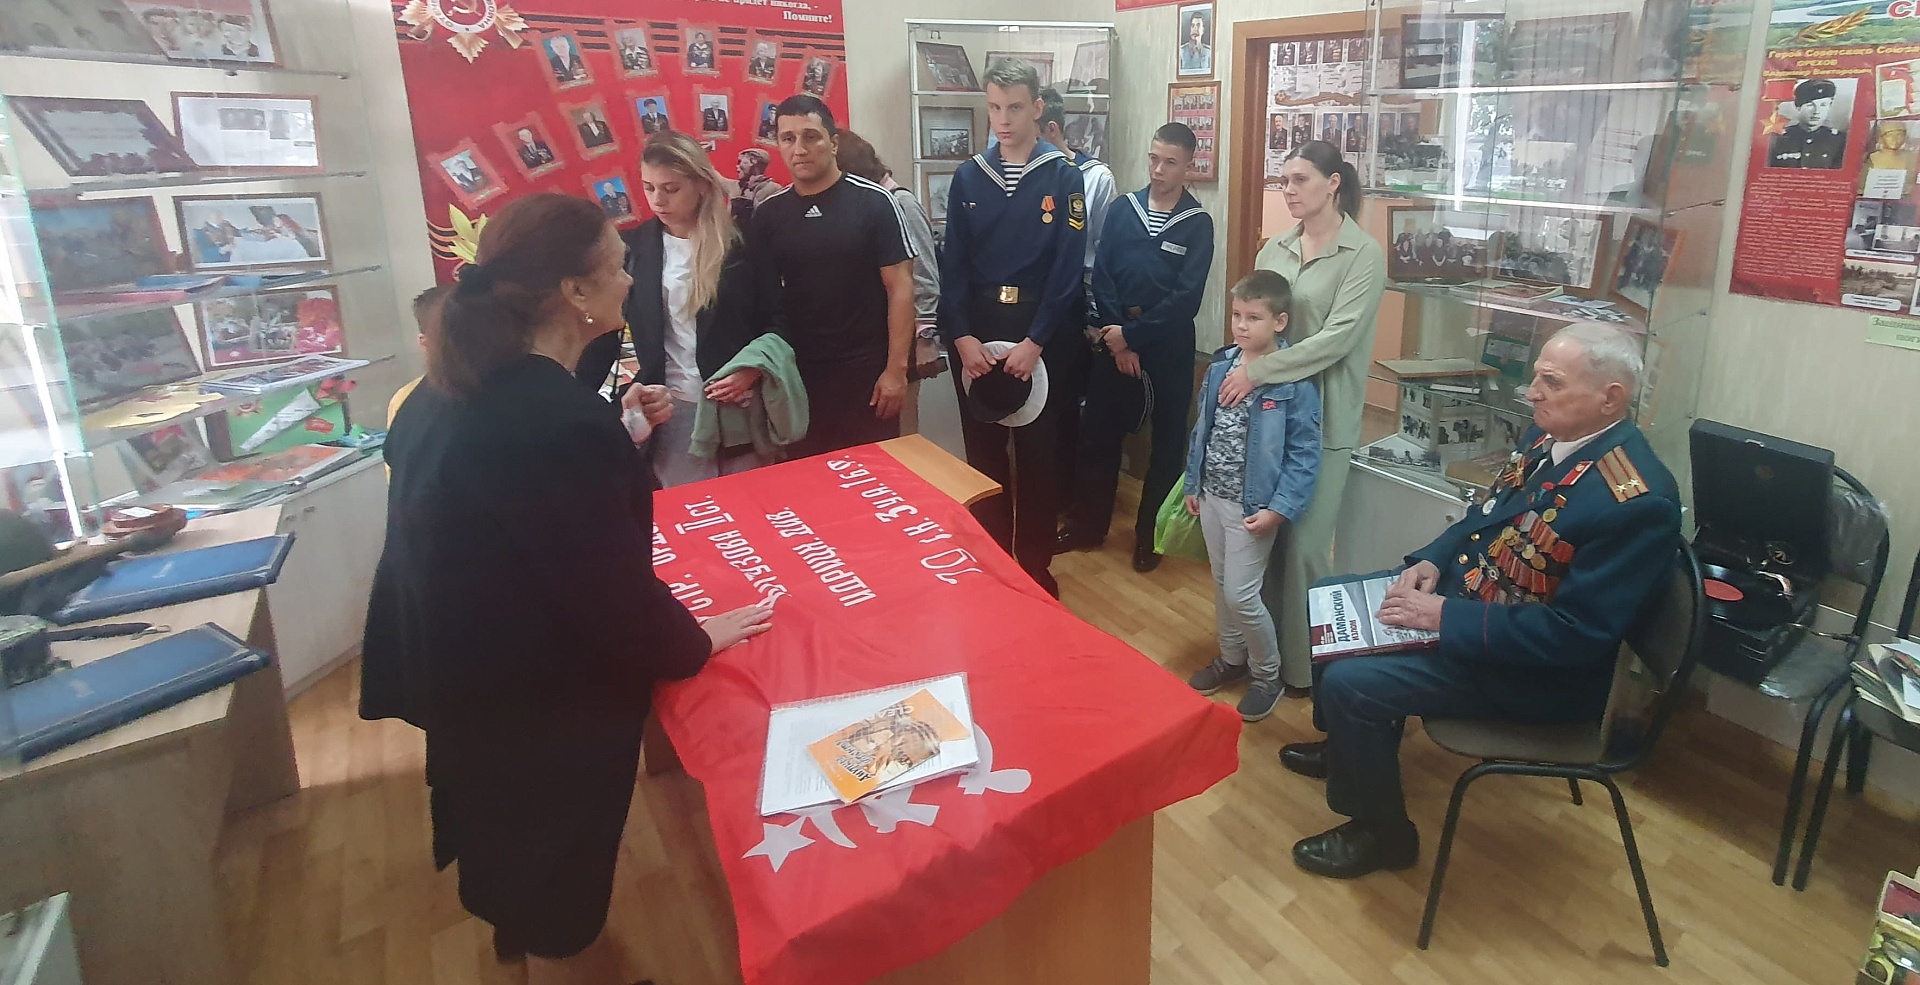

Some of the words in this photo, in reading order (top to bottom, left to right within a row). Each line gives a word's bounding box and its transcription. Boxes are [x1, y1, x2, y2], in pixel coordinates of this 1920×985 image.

[782, 10, 833, 24] Помните!
[1330, 589, 1351, 643] ДАМАНСКИЙ
[1349, 619, 1360, 641] ИЗЛОМ
